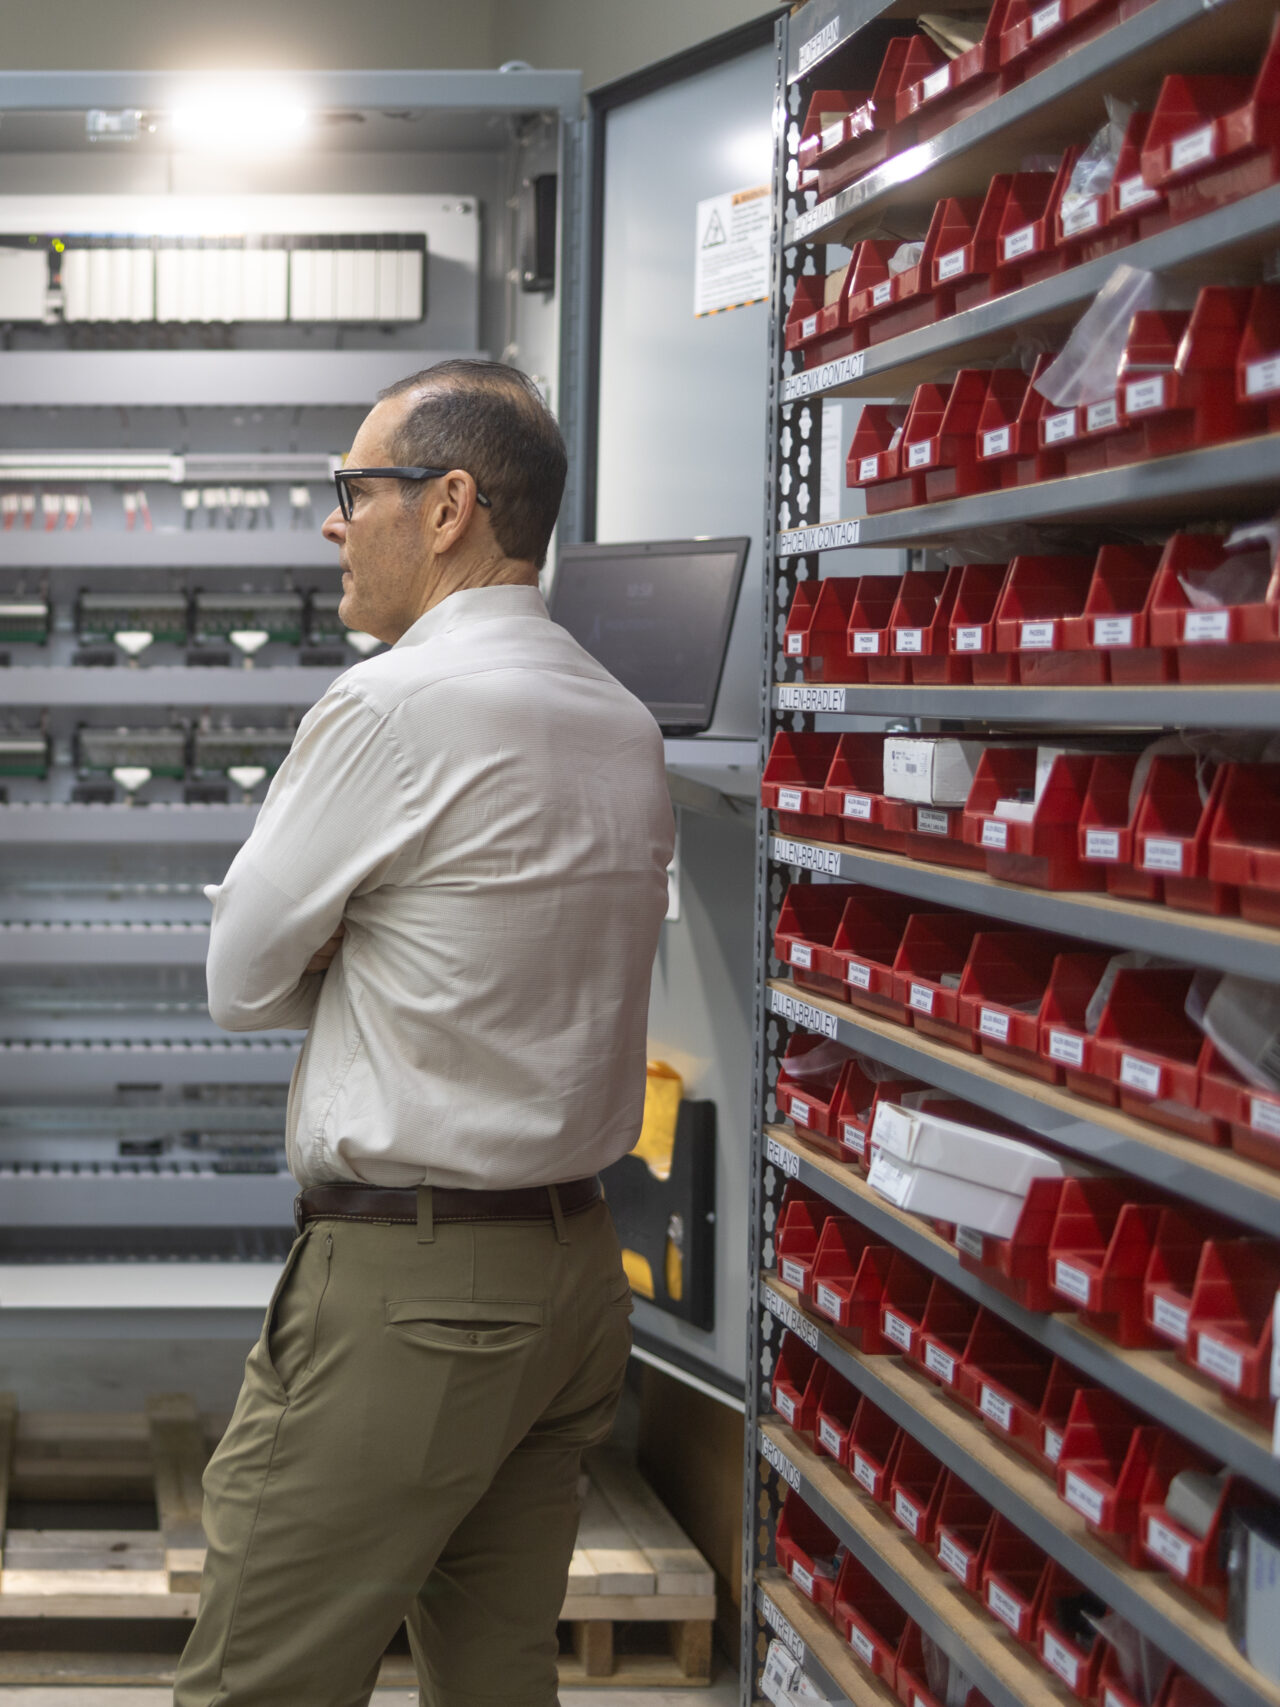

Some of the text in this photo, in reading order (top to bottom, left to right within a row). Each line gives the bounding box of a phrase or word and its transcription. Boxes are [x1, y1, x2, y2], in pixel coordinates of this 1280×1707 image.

[799, 19, 838, 69] HOFFMAN
[785, 354, 864, 397] PHOENIX CONTACT
[781, 521, 859, 554] PHOENIX CONTACT
[780, 690, 845, 711] ALLEN-BRADLEY
[775, 841, 840, 874] ALLEN-BRADLEY
[772, 992, 838, 1039] ALLEN-BRADLEY
[769, 1140, 798, 1176] RELAYS
[765, 1288, 817, 1349] RELAY BASES
[762, 1437, 800, 1489] GROUNDS
[764, 1597, 803, 1662] ENTRELEC
